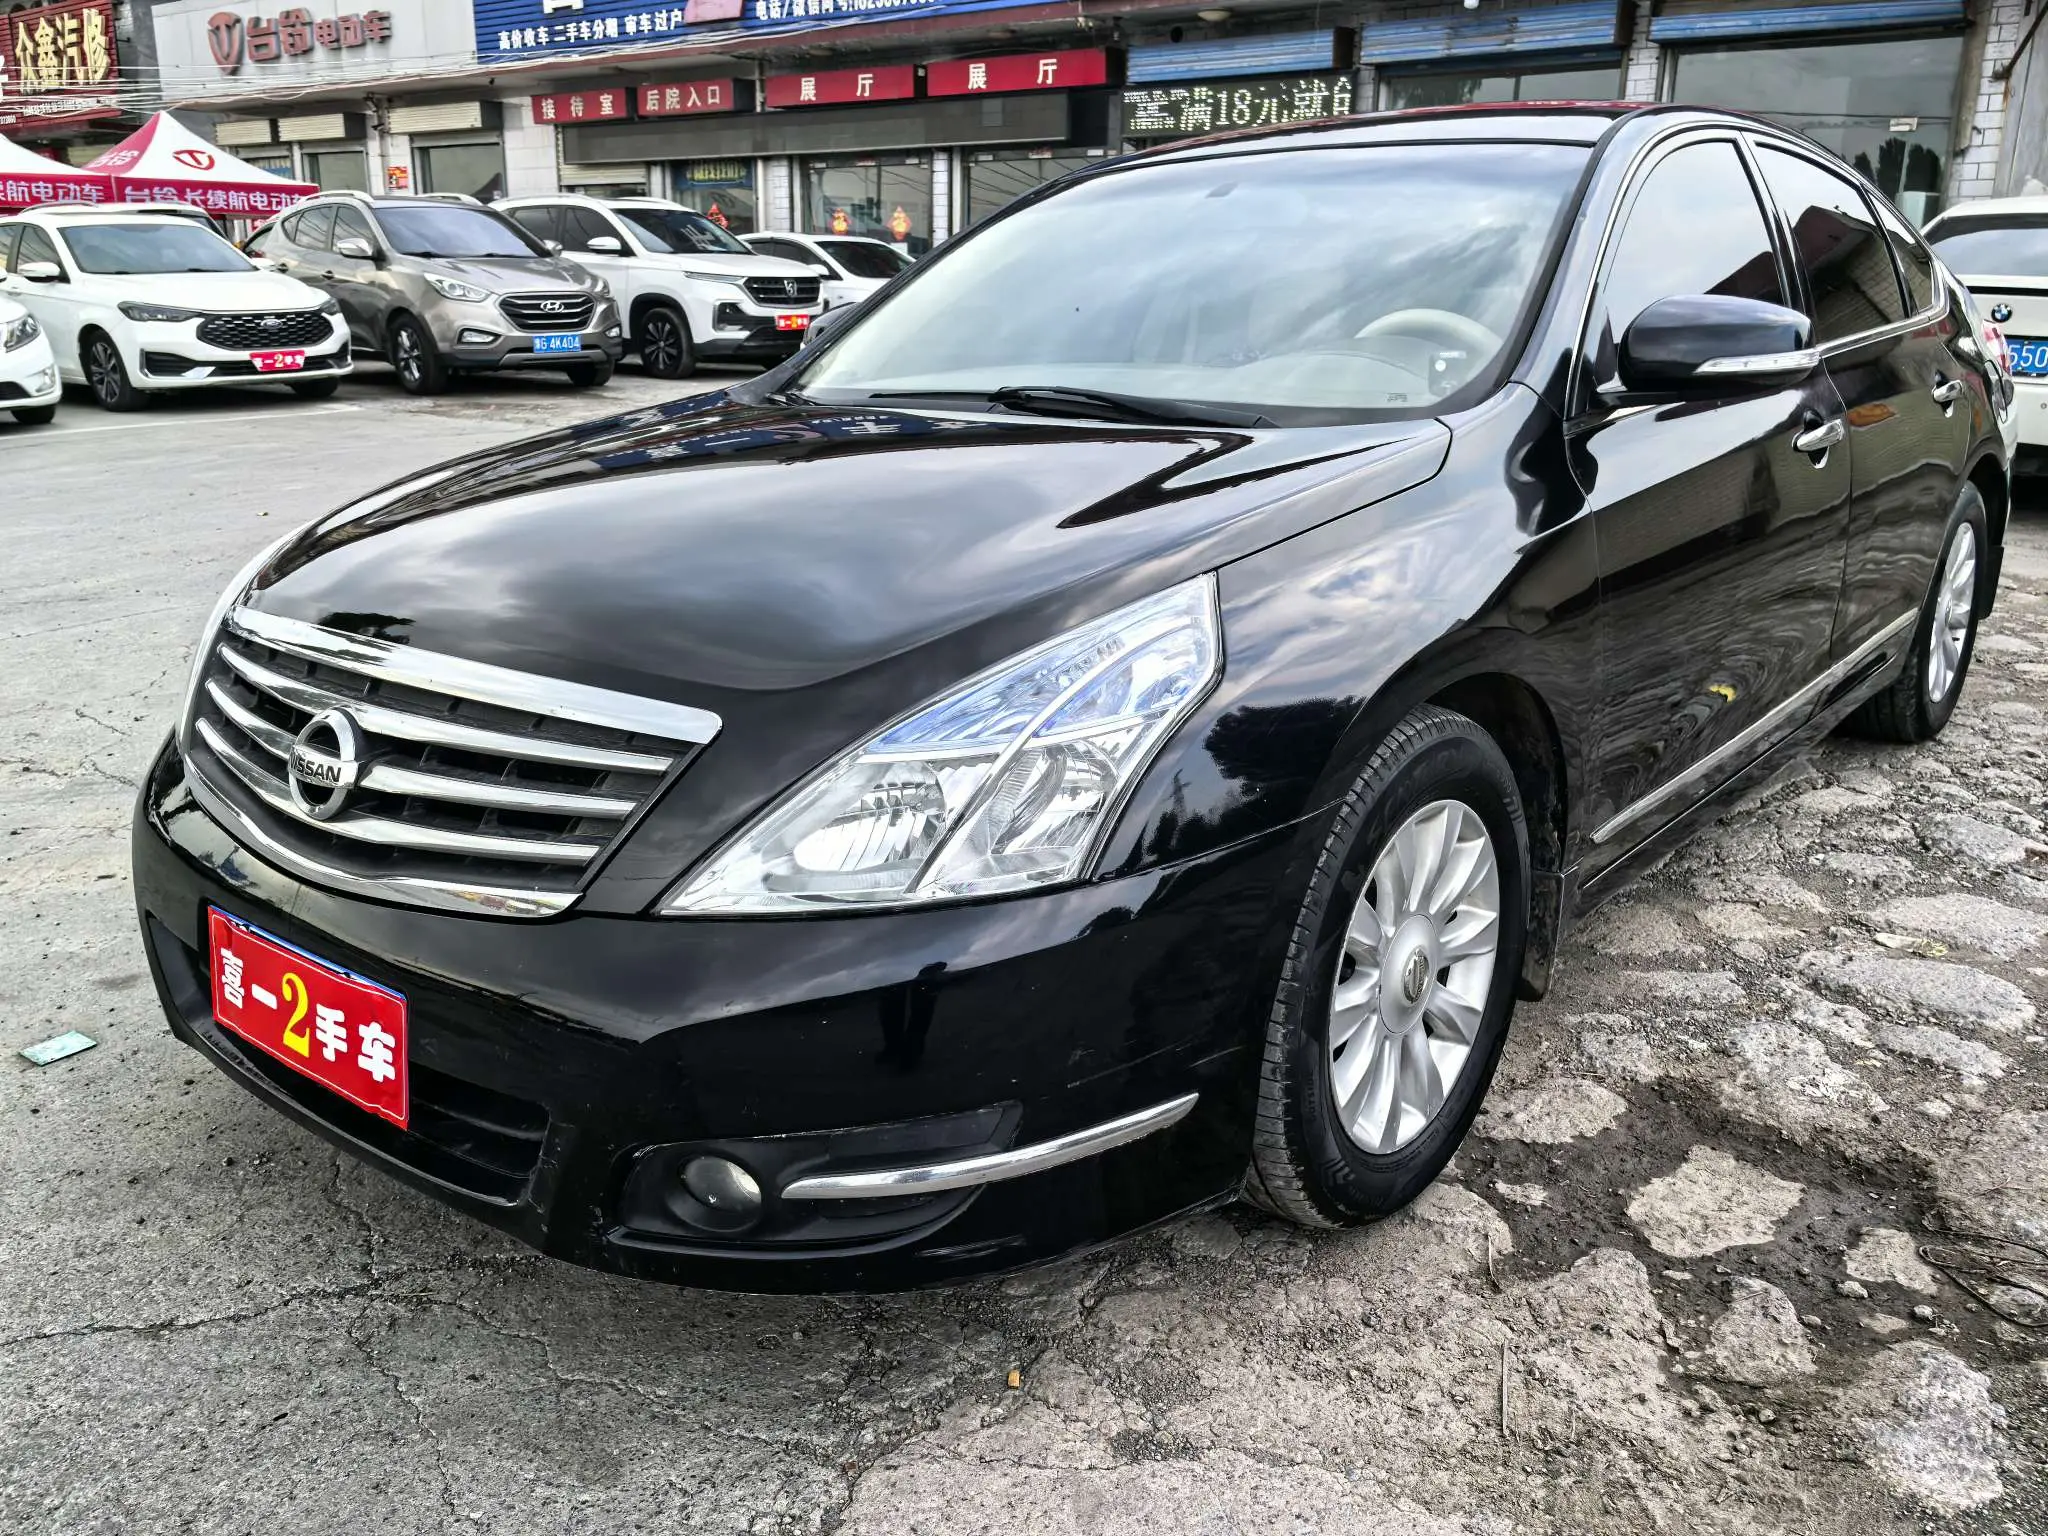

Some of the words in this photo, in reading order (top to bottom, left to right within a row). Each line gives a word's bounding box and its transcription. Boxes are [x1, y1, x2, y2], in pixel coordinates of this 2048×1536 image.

[498, 26, 549, 50] 高价收车
[554, 17, 618, 43] 二手车分期
[800, 73, 874, 102] 展厅
[967, 57, 1058, 90] 展厅
[541, 93, 615, 120] 接待室
[646, 86, 720, 112] 后院入口
[220, 947, 397, 1083] 喜一2手车
